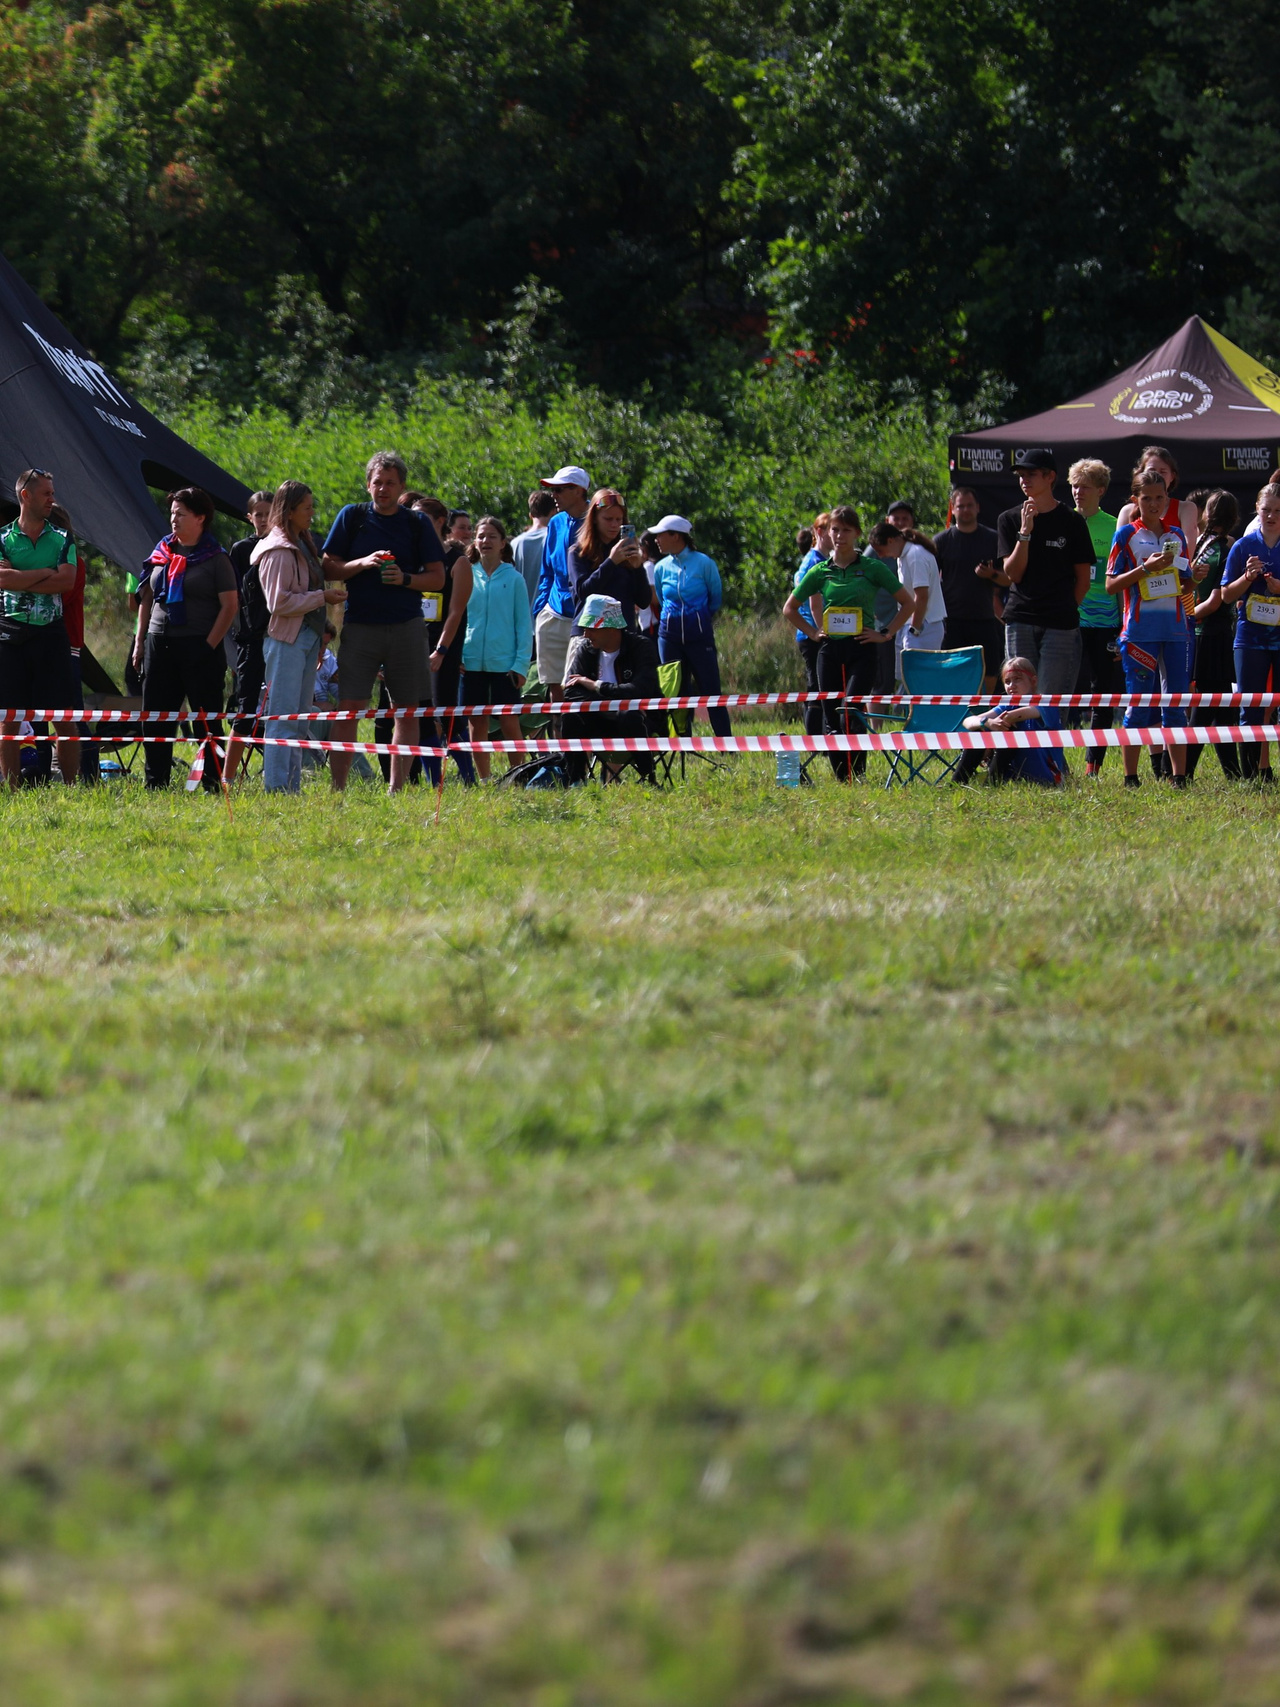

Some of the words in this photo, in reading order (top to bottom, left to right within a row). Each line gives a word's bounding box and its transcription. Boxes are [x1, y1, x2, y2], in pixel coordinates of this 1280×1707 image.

[1133, 399, 1183, 410] BAND
[960, 448, 1005, 460] TIMING
[1226, 447, 1271, 459] TIMING
[971, 459, 1004, 472] BAND
[1237, 459, 1270, 470] BAND
[1150, 579, 1168, 588] 220.1
[1257, 605, 1275, 615] 239.3
[833, 617, 851, 625] 204.3
